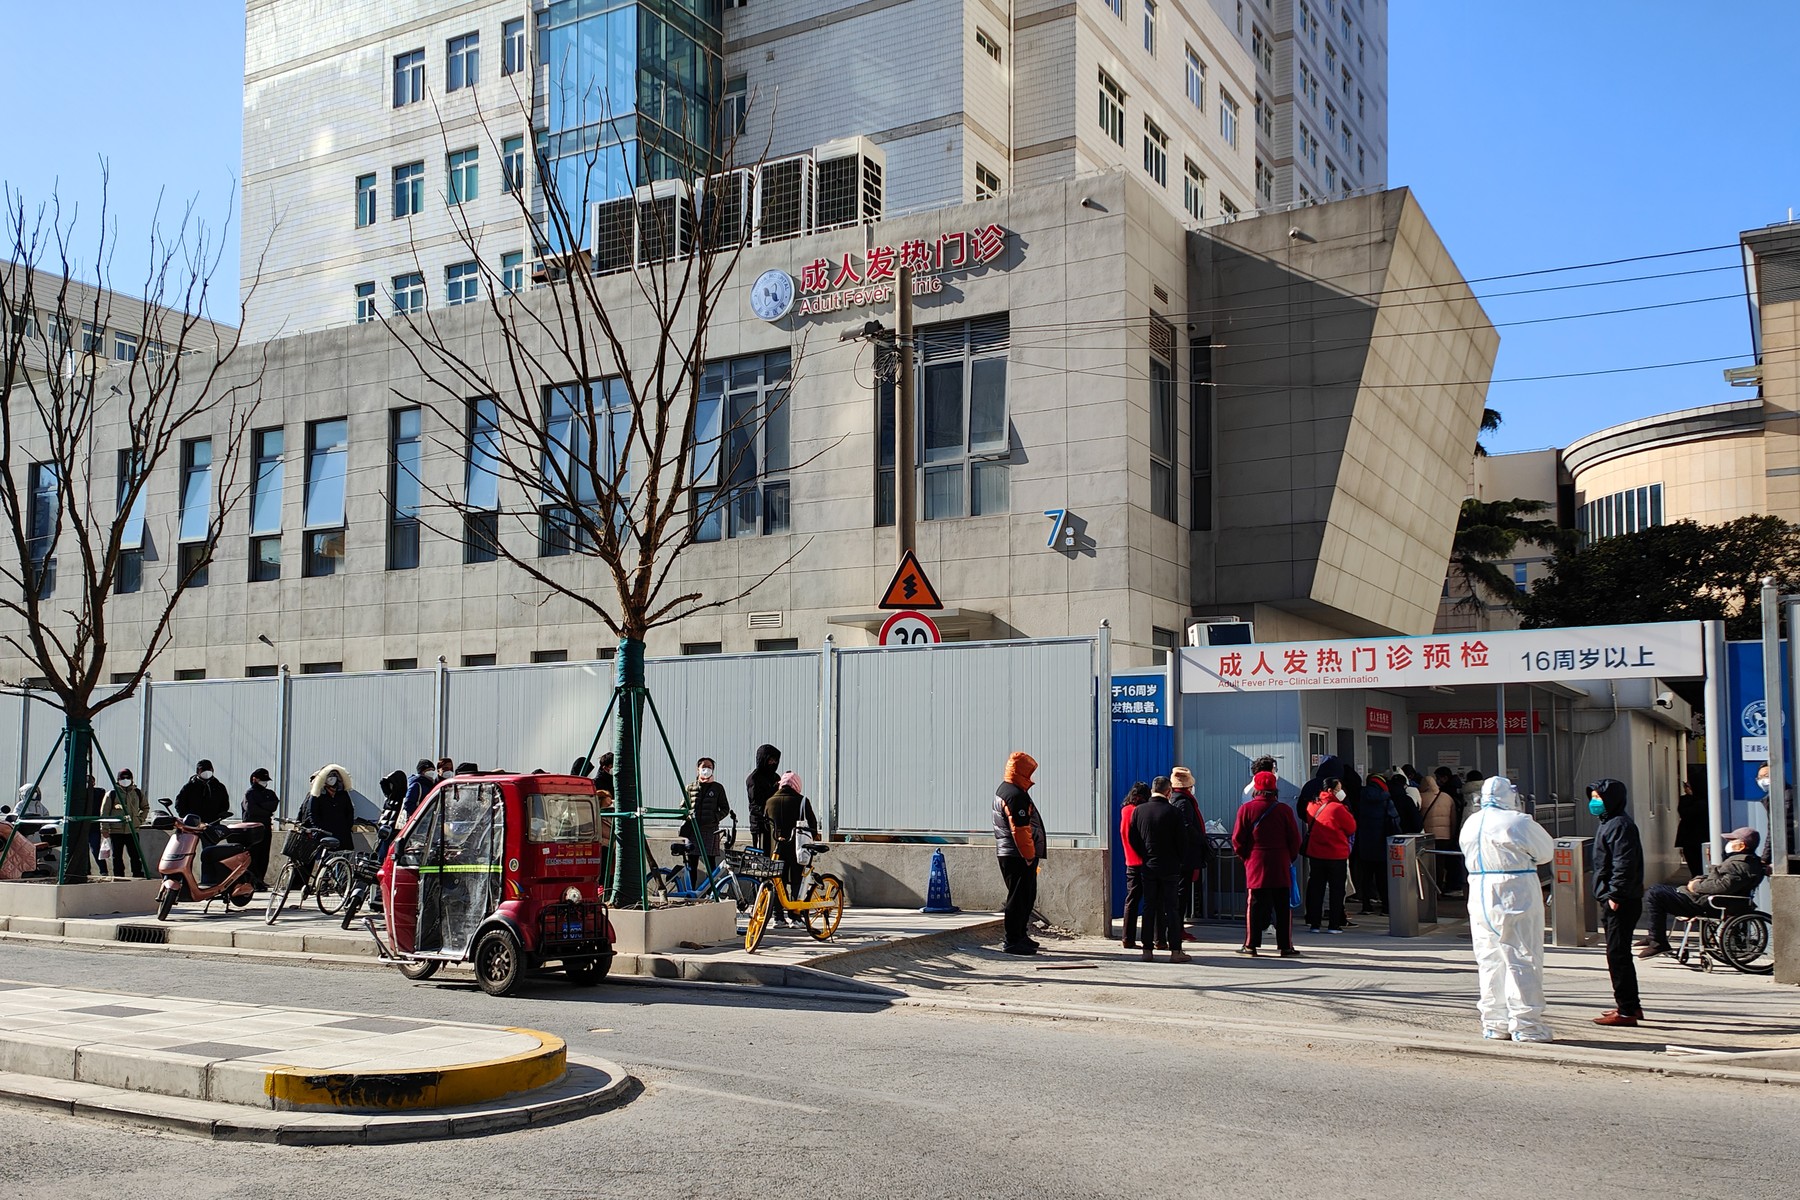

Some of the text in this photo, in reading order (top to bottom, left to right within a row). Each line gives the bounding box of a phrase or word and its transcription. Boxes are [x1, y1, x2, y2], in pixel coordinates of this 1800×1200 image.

[799, 224, 1005, 293] 成人发热门诊
[799, 294, 840, 316] Adult
[843, 287, 891, 308] Fever
[911, 276, 944, 296] inic
[1218, 640, 1656, 677] 成人发热门诊预检 16周岁以上
[1218, 675, 1379, 688] Adult Fever Pre-Clinical Examination
[1555, 849, 1573, 883] 出口
